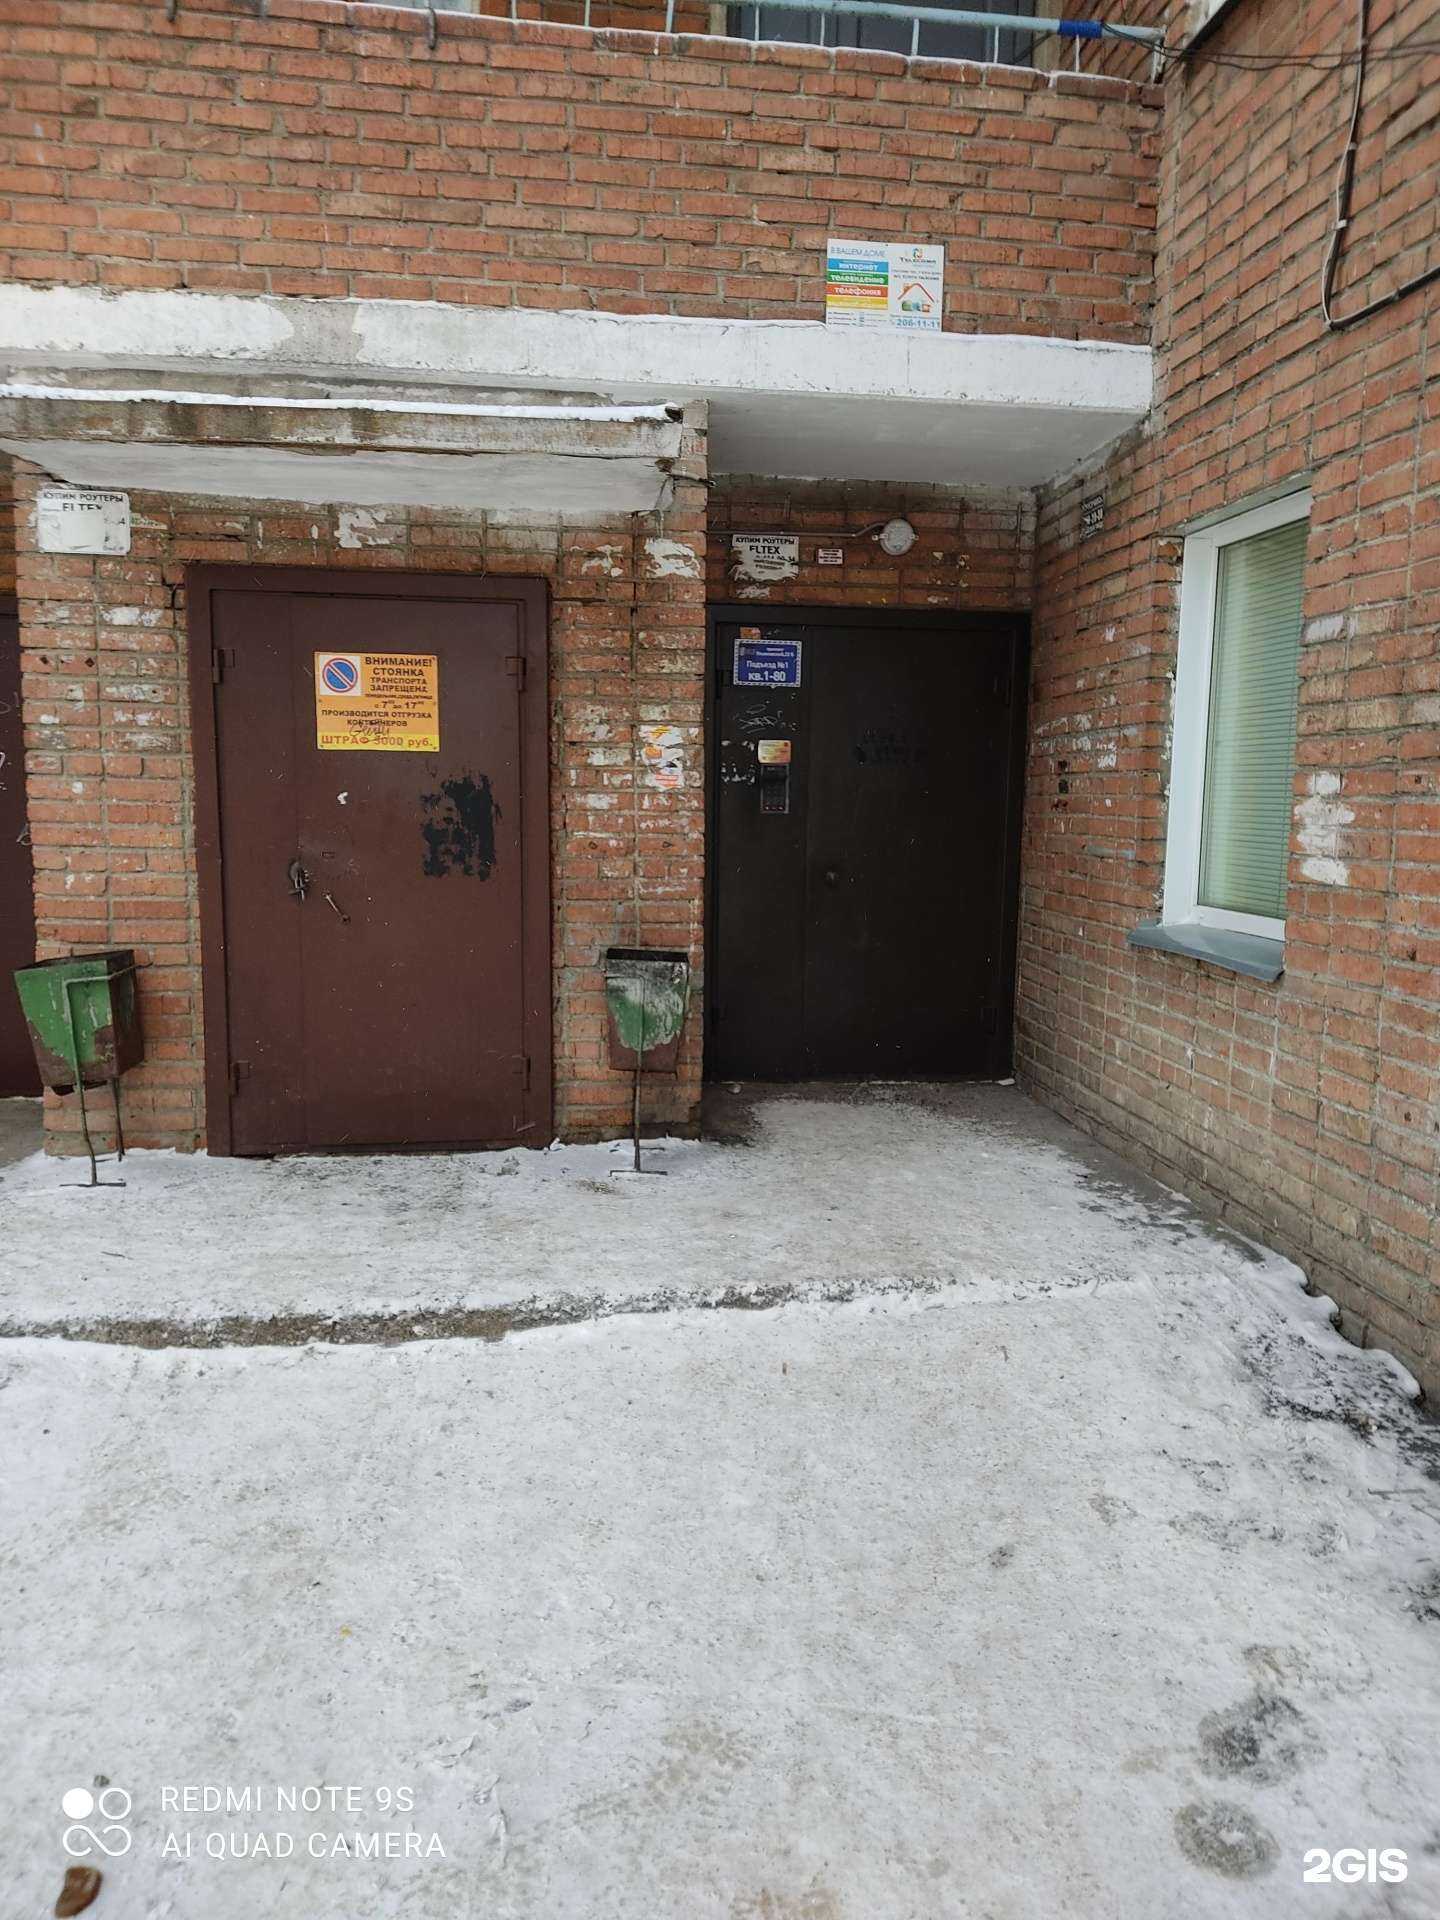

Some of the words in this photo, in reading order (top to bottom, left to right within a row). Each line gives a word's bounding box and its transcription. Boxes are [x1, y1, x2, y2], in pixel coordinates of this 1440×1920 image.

[365, 656, 432, 667] ВНИМАНИЕ!
[373, 667, 425, 677] СТОЯНКА
[370, 677, 428, 685] ТРАНСПОРТА
[370, 684, 429, 693] ЗАПРЕЩЕНА
[321, 709, 389, 718] ПРОИЗВОДИТСЯ
[391, 711, 432, 719] ОТГРУЗКА
[321, 735, 369, 744] ШТРАФ
[408, 738, 433, 747] руб.
